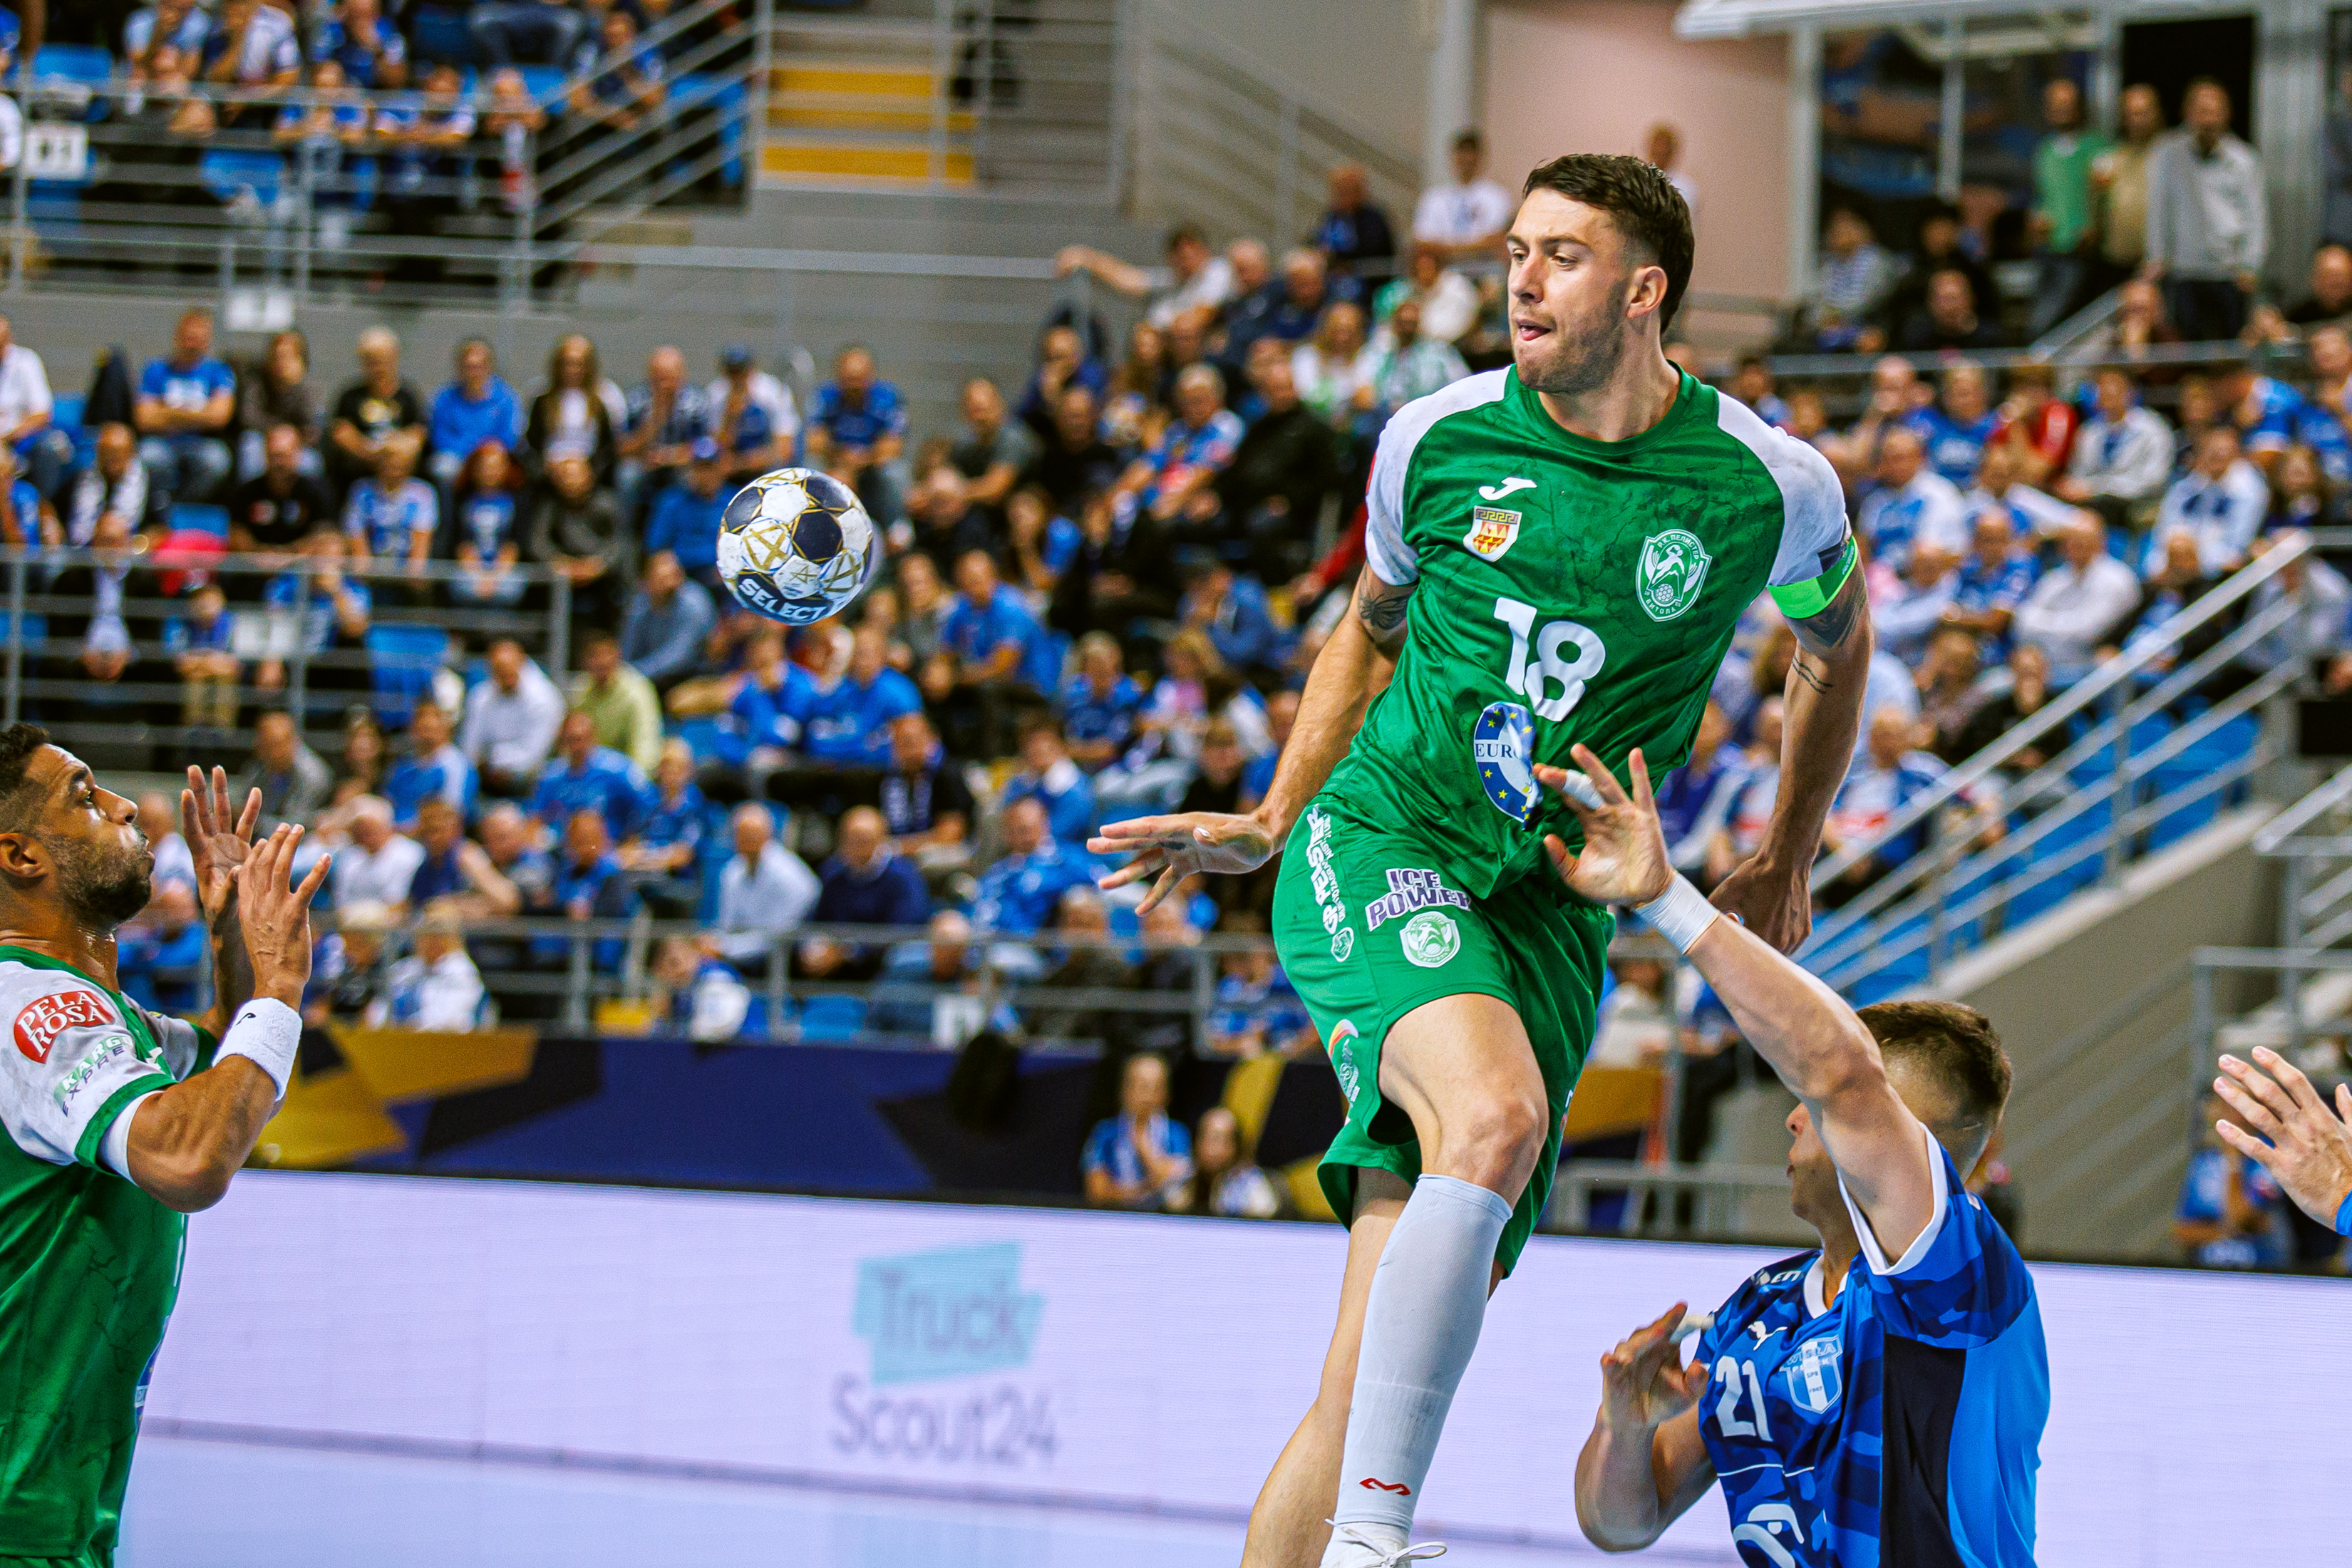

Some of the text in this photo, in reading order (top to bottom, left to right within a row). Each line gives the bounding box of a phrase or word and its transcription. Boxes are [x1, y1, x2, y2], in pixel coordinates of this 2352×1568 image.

[1670, 535, 1699, 559] ПЕЛИСТЕР
[738, 578, 827, 620] SELECT
[1493, 597, 1606, 722] 18
[1475, 743, 1519, 759] EUR
[1387, 868, 1441, 892] ICE
[1322, 904, 1338, 934] GP
[17, 991, 98, 1038] PELA
[29, 1006, 106, 1058] ROSA
[877, 1267, 1029, 1359] Truck
[830, 1372, 1059, 1468] Scout24
[1715, 1355, 1774, 1442] 21
